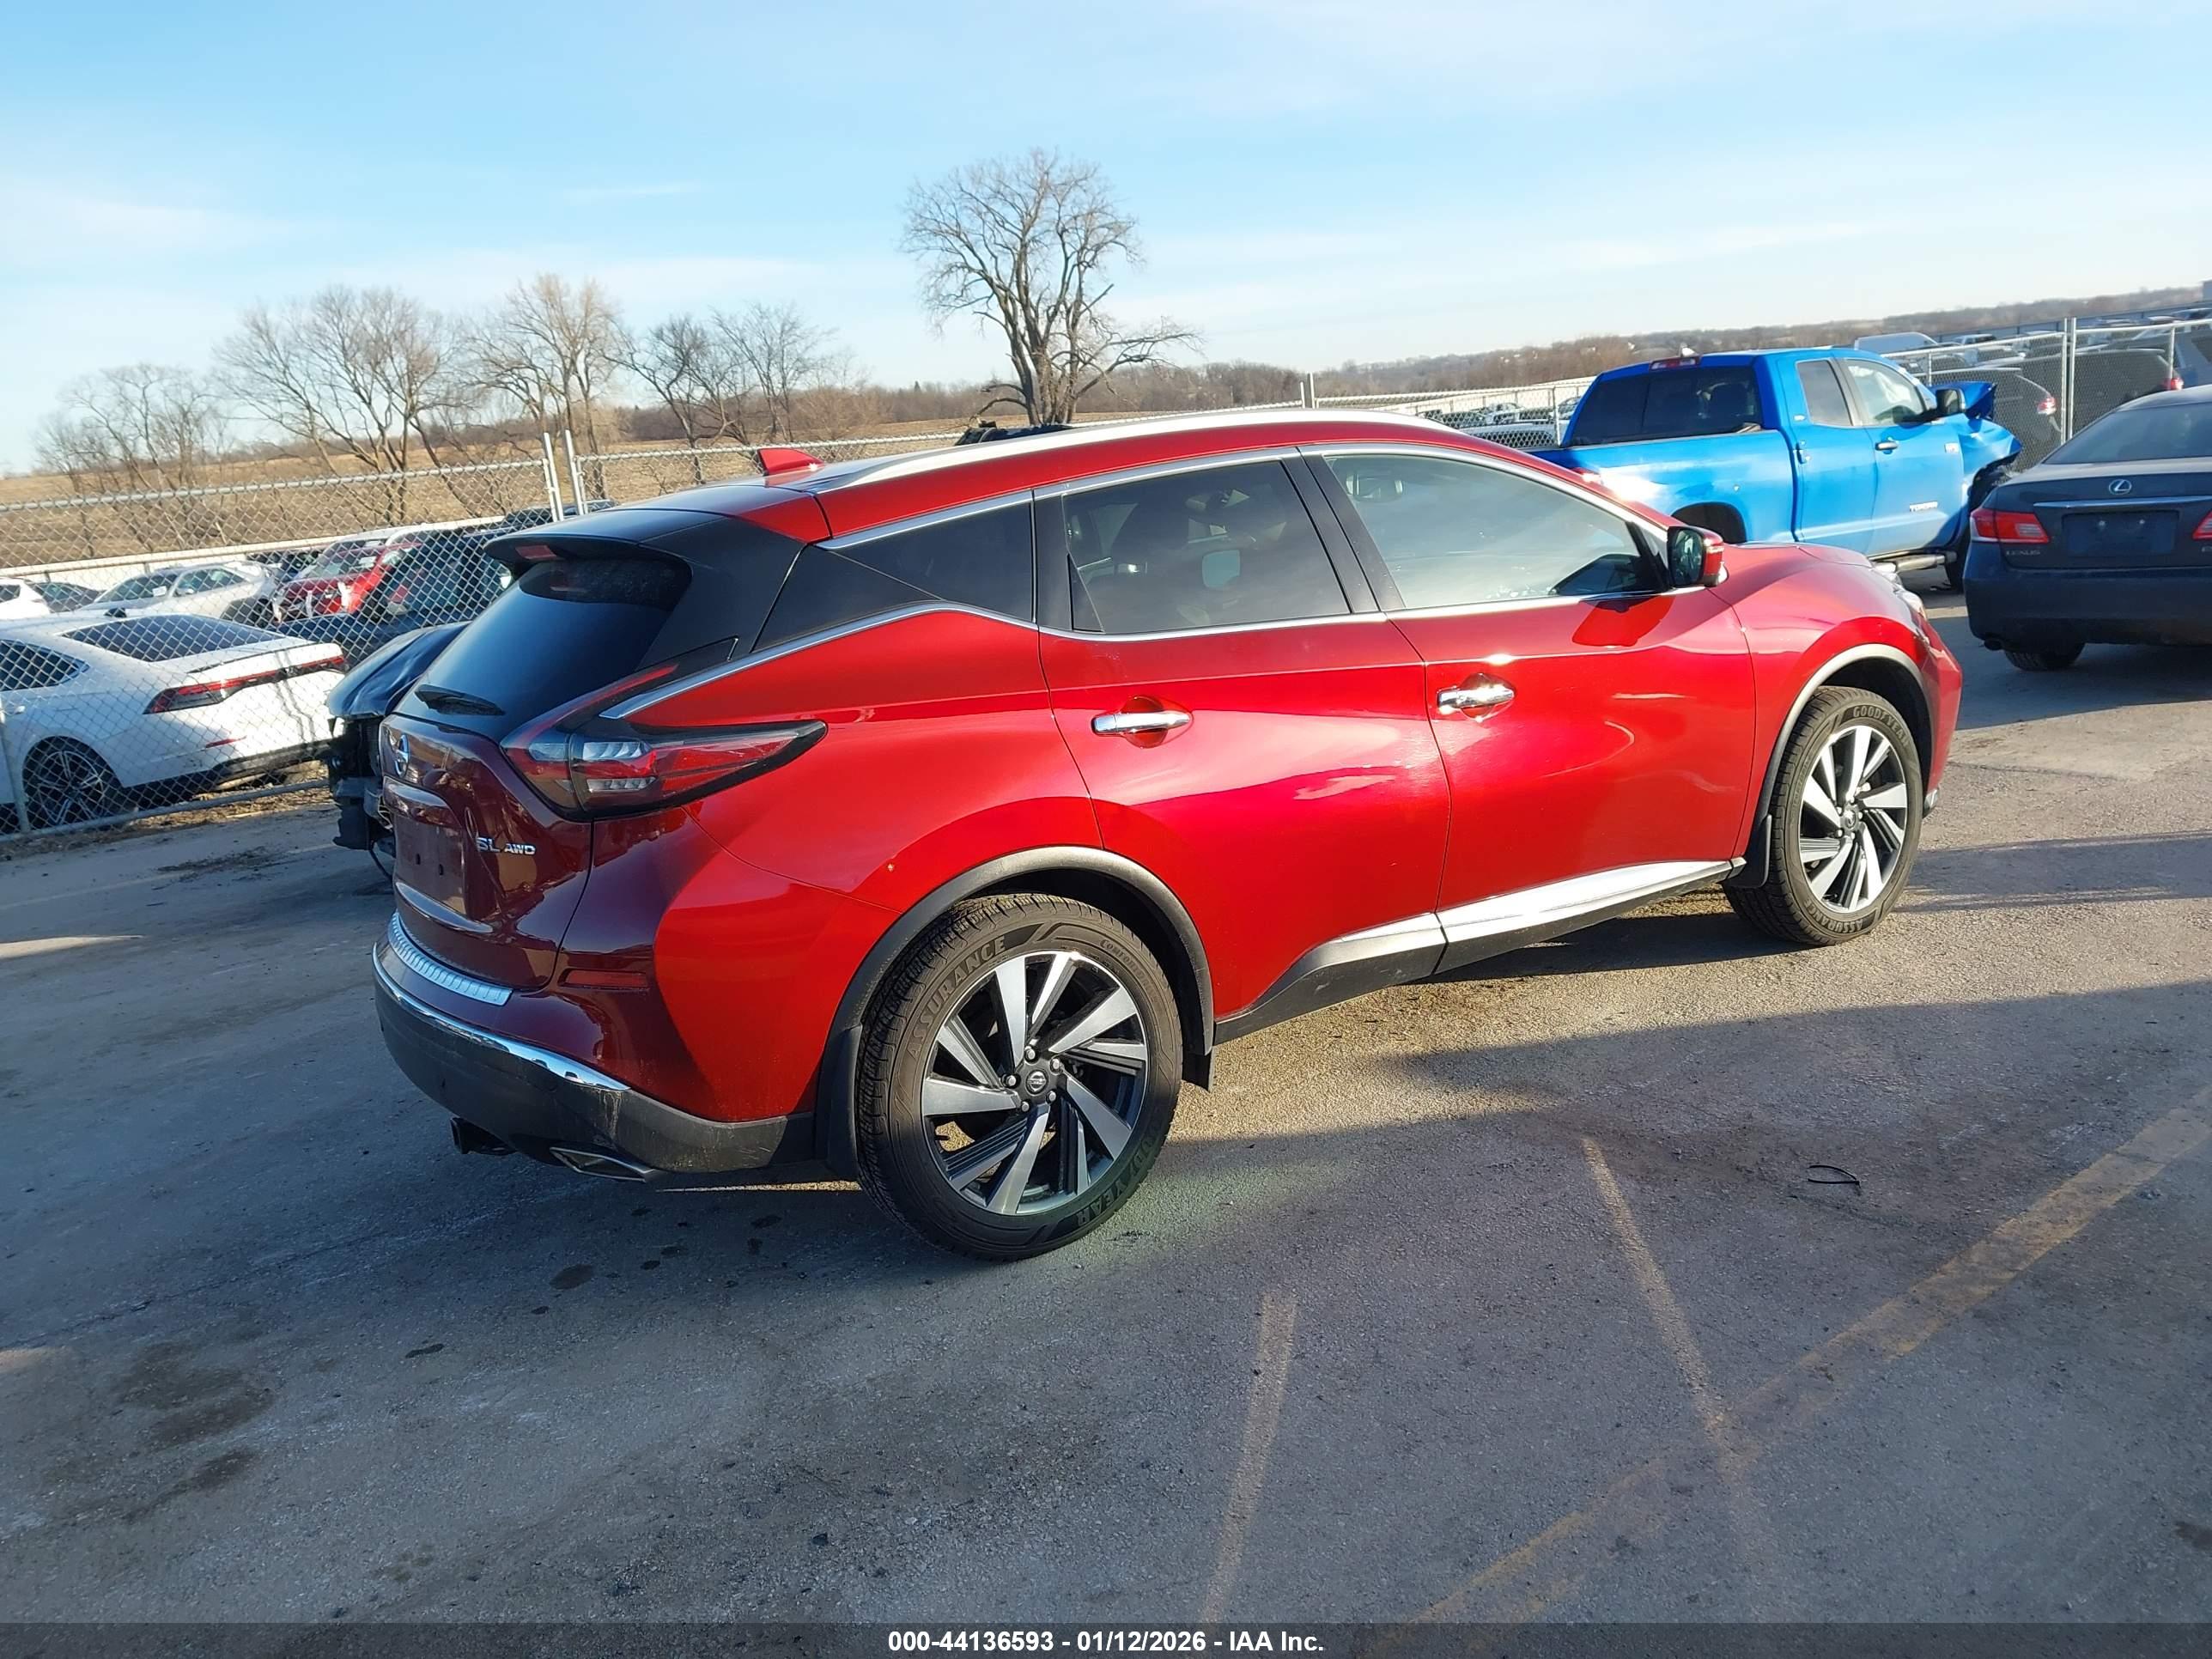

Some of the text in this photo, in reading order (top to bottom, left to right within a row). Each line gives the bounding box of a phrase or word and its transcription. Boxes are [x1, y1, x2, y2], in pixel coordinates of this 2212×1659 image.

[1853, 705, 1911, 747] GOODYEAR
[476, 837, 537, 855] SL AWD
[1804, 898, 1863, 934] ASSURANCE
[906, 935, 1006, 1060] ASSURANCE
